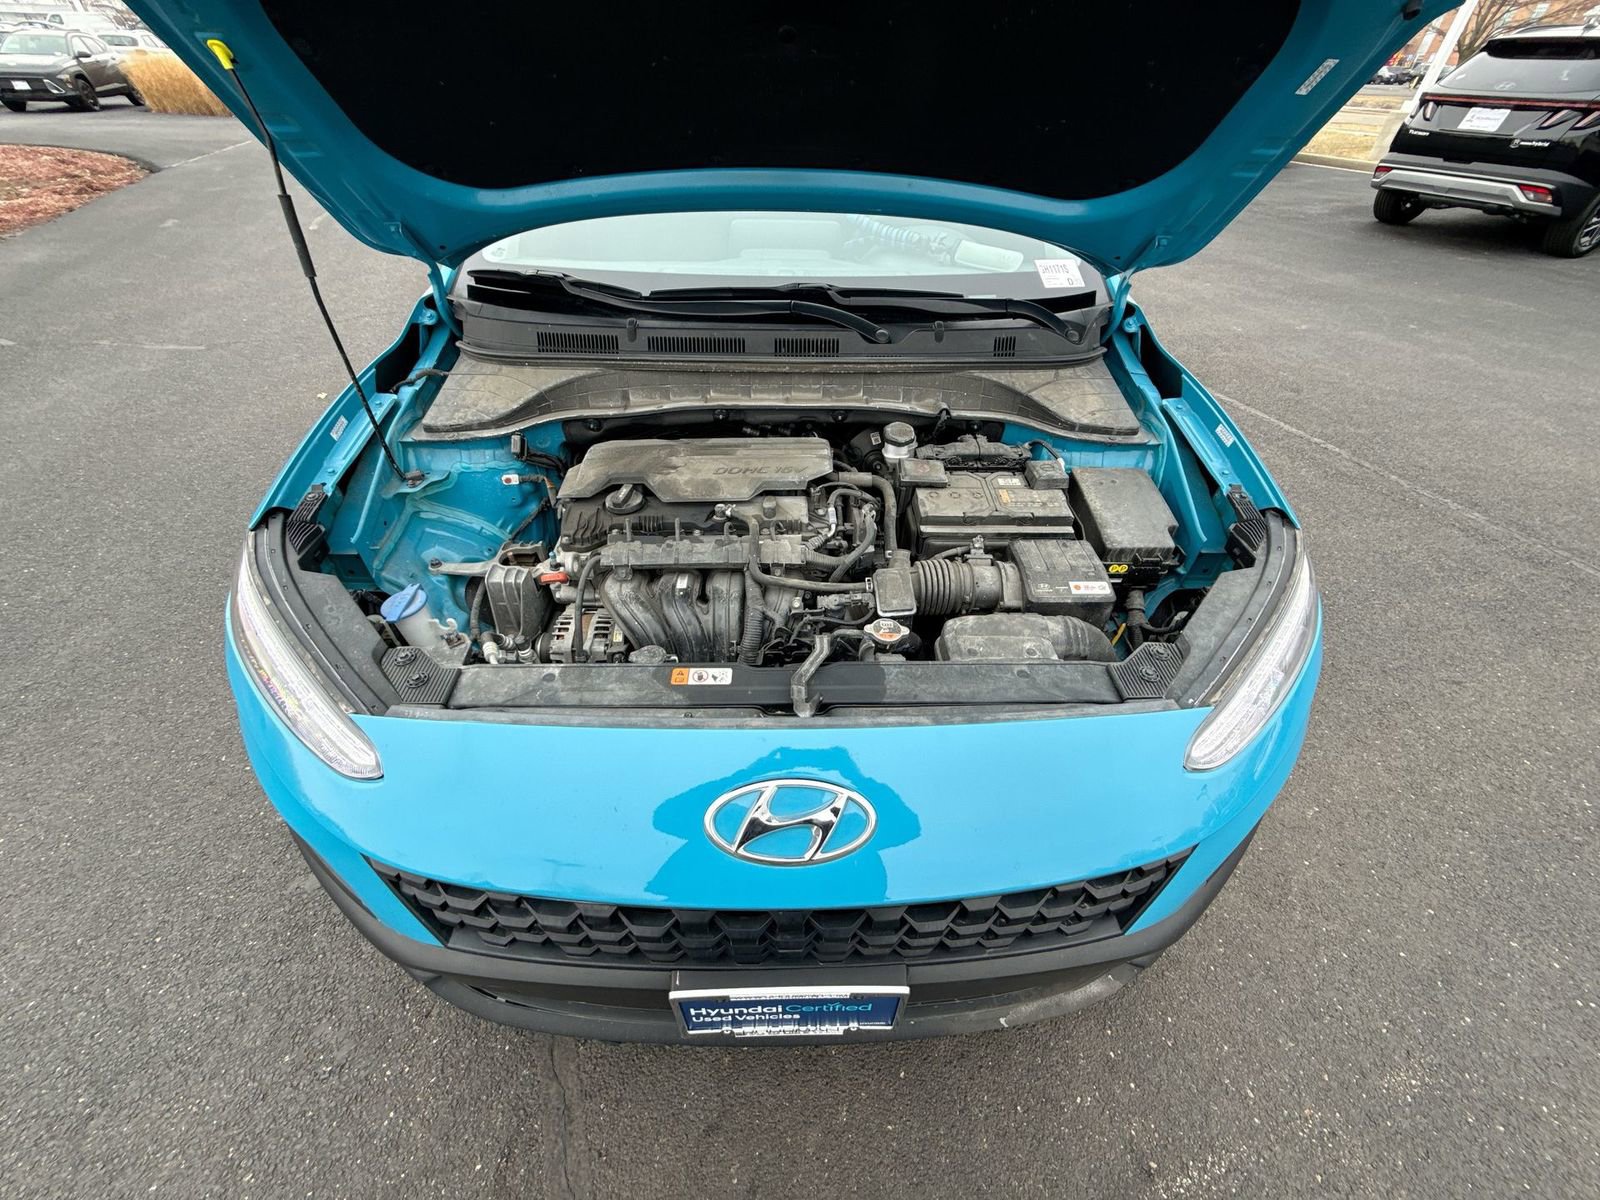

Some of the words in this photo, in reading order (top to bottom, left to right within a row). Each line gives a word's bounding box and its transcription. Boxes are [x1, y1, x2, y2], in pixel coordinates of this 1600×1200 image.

[713, 466, 770, 475] DOHC
[690, 1005, 782, 1016] Hyundai
[786, 1002, 872, 1012] Certified
